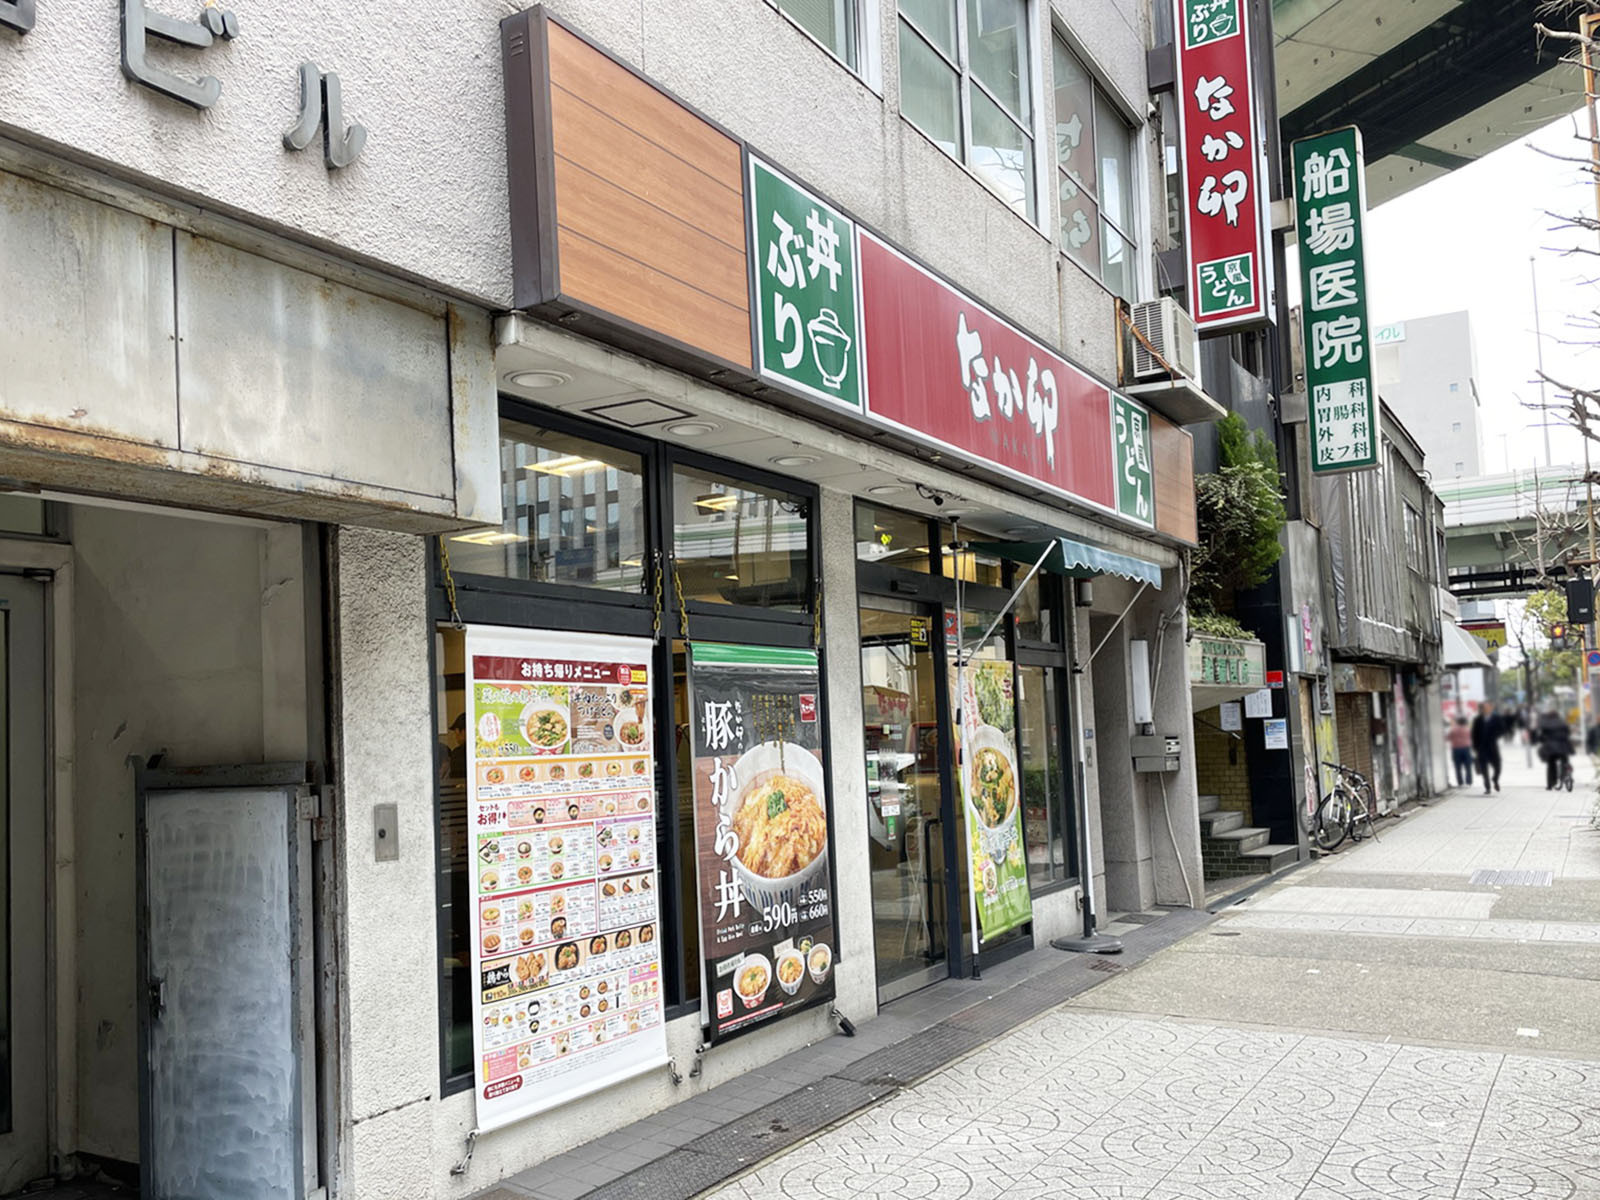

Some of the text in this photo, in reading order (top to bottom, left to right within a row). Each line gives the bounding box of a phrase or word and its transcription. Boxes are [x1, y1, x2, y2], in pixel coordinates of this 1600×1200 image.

[1194, 76, 1248, 227] なか卯
[1201, 266, 1245, 307] うどん
[1303, 147, 1363, 370] 船場医院
[956, 310, 1060, 473] なか卯
[1317, 402, 1366, 423] 胃腸科
[1115, 403, 1149, 518] うどん
[1320, 442, 1369, 462] 皮フ科
[704, 699, 746, 923] 豚から丼
[764, 902, 799, 933] 590円
